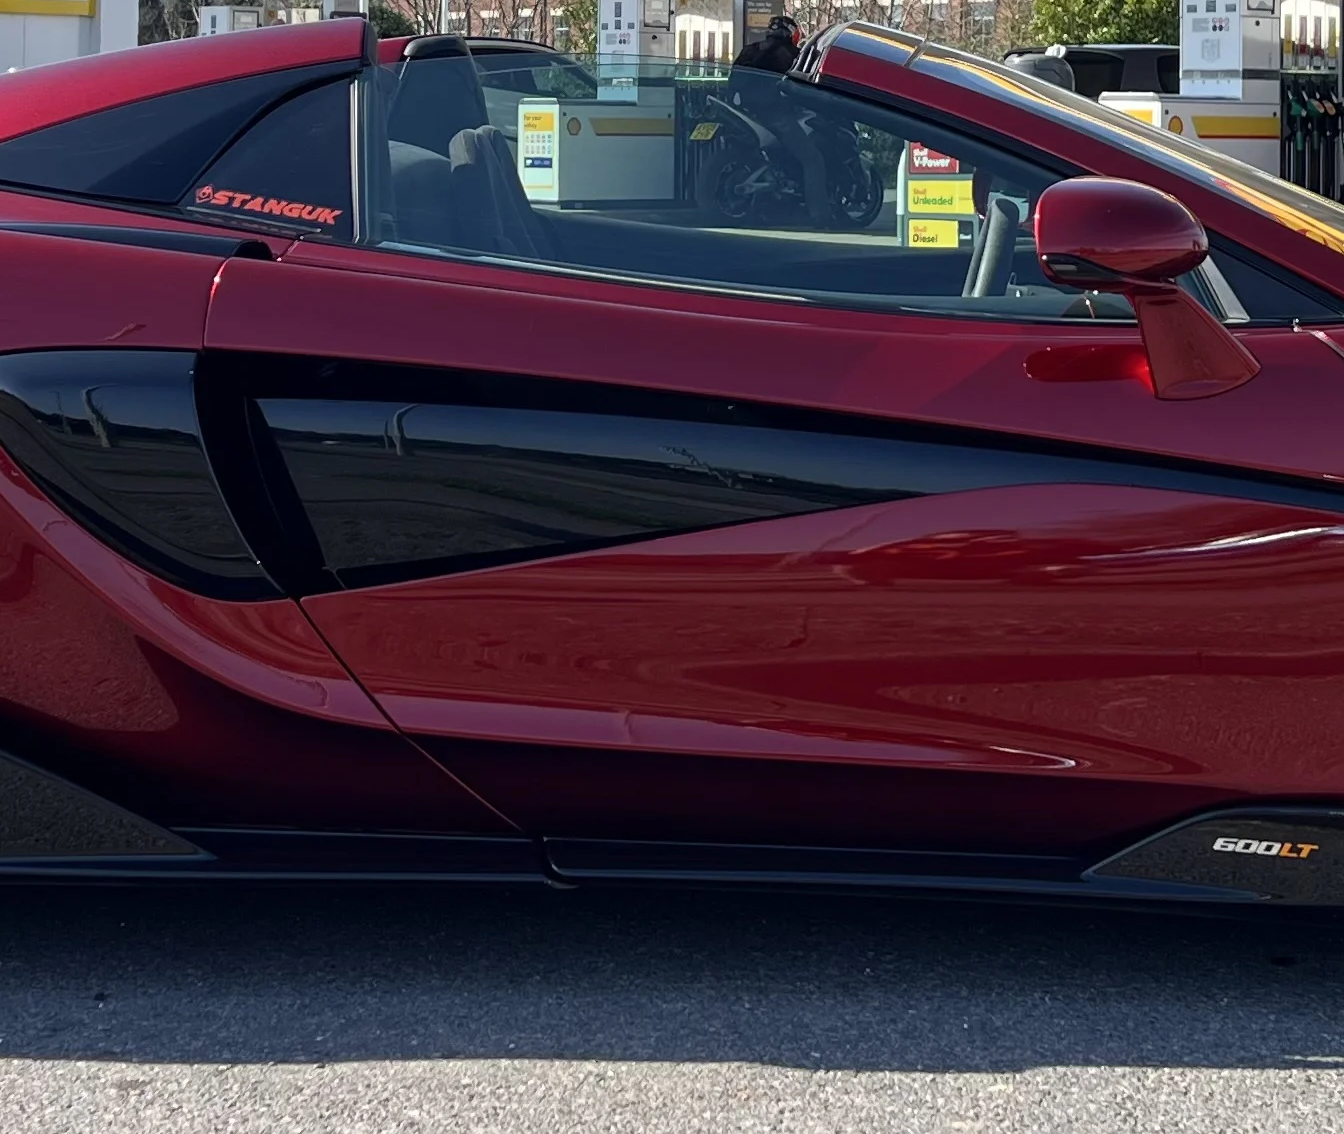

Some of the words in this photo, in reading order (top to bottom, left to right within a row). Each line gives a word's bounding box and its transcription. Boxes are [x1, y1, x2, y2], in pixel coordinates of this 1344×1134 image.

[912, 195, 954, 206] Unleaded
[912, 233, 938, 243] Diesel
[1212, 837, 1320, 859] 600LT
